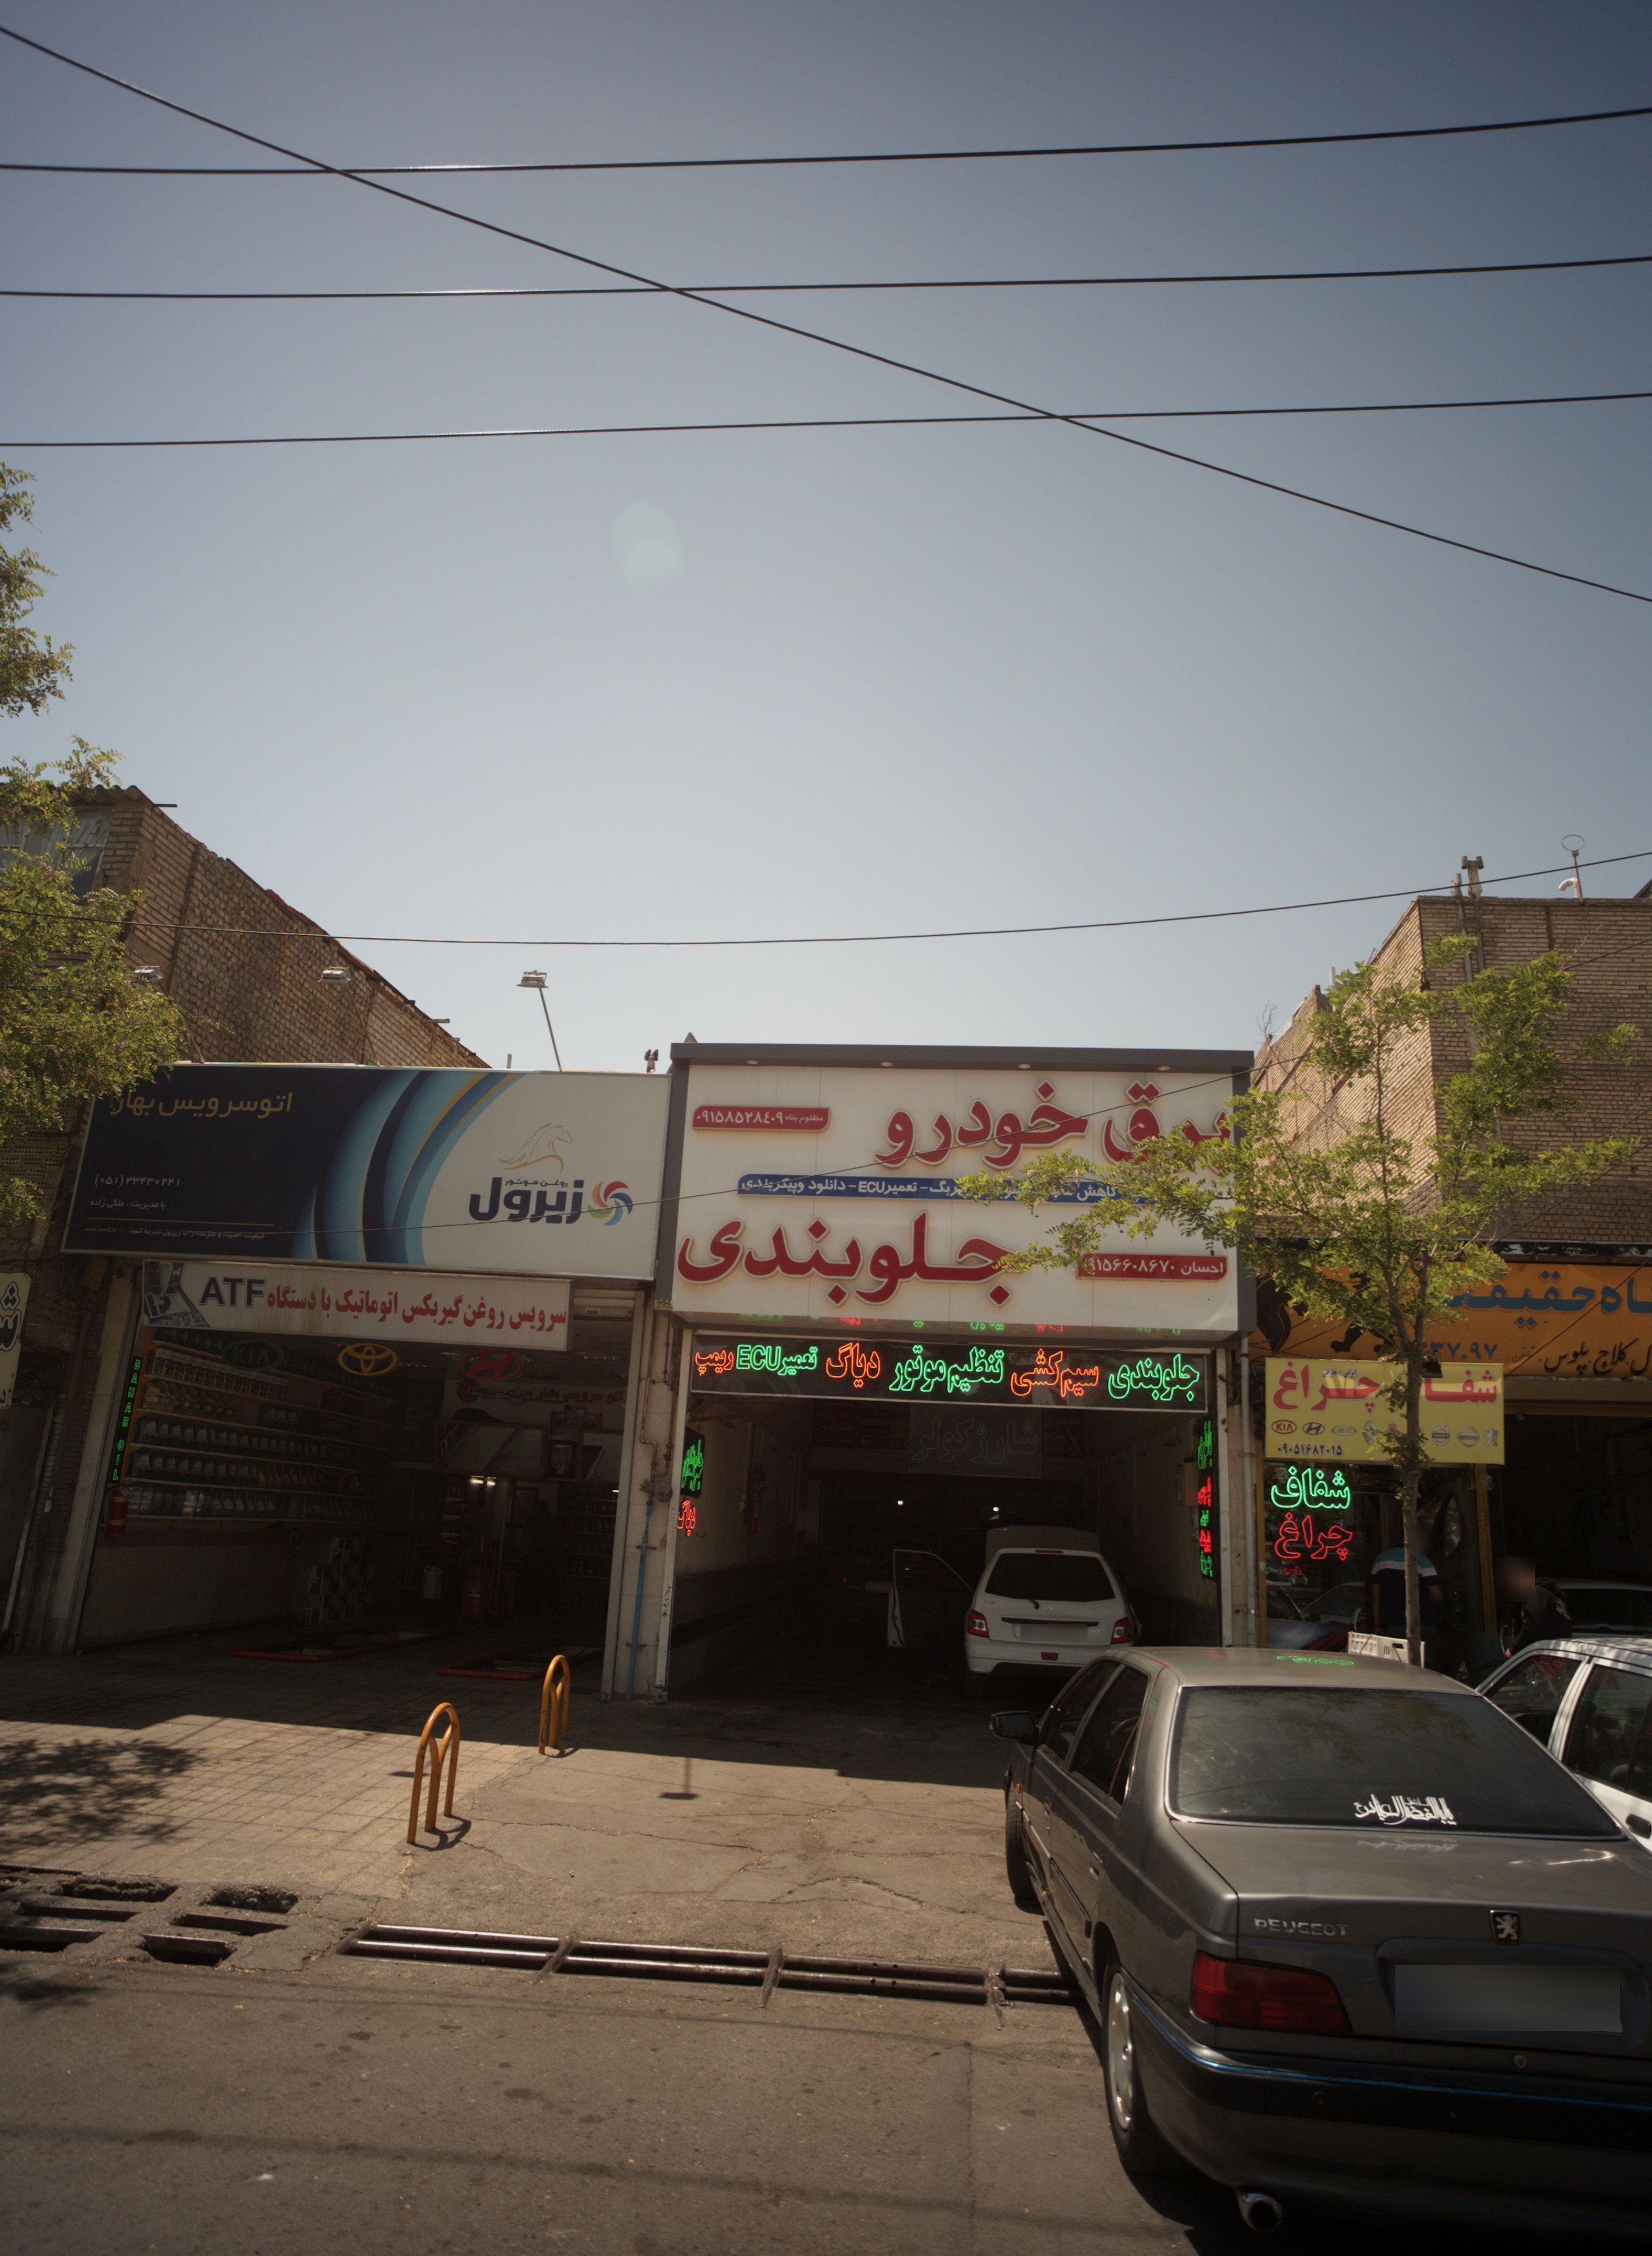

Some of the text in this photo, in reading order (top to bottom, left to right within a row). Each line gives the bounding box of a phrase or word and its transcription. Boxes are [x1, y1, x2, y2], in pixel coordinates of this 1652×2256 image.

[874, 1080, 1090, 1169] خودرو
[469, 1176, 584, 1224] زیرول
[505, 1179, 568, 1187] روغن موتور
[808, 1179, 846, 1195] دانلود
[677, 1210, 1021, 1308] جلوبندی
[1181, 1261, 1224, 1276] احسان
[199, 1276, 266, 1308] ATF
[268, 1285, 567, 1332] سرویس روغن گیربکس اتوماتیک با دستگاه
[735, 1344, 782, 1371] ECU
[777, 1345, 819, 1376] تعمیر
[825, 1342, 881, 1389] دیاگ
[888, 1343, 947, 1393] موتور
[946, 1346, 1006, 1394] تنظیم
[1107, 1353, 1200, 1402] جلوبندی
[1544, 1341, 1590, 1376] پلوس
[1273, 1360, 1381, 1413] چراغ
[911, 1416, 975, 1462] کولر
[971, 1420, 1038, 1465] شارژ
[1276, 1423, 1293, 1431] KIA
[1270, 1465, 1351, 1510] شفاف
[1274, 1511, 1354, 1562] چراغ
[1254, 1918, 1349, 1937] PEUGEOT
